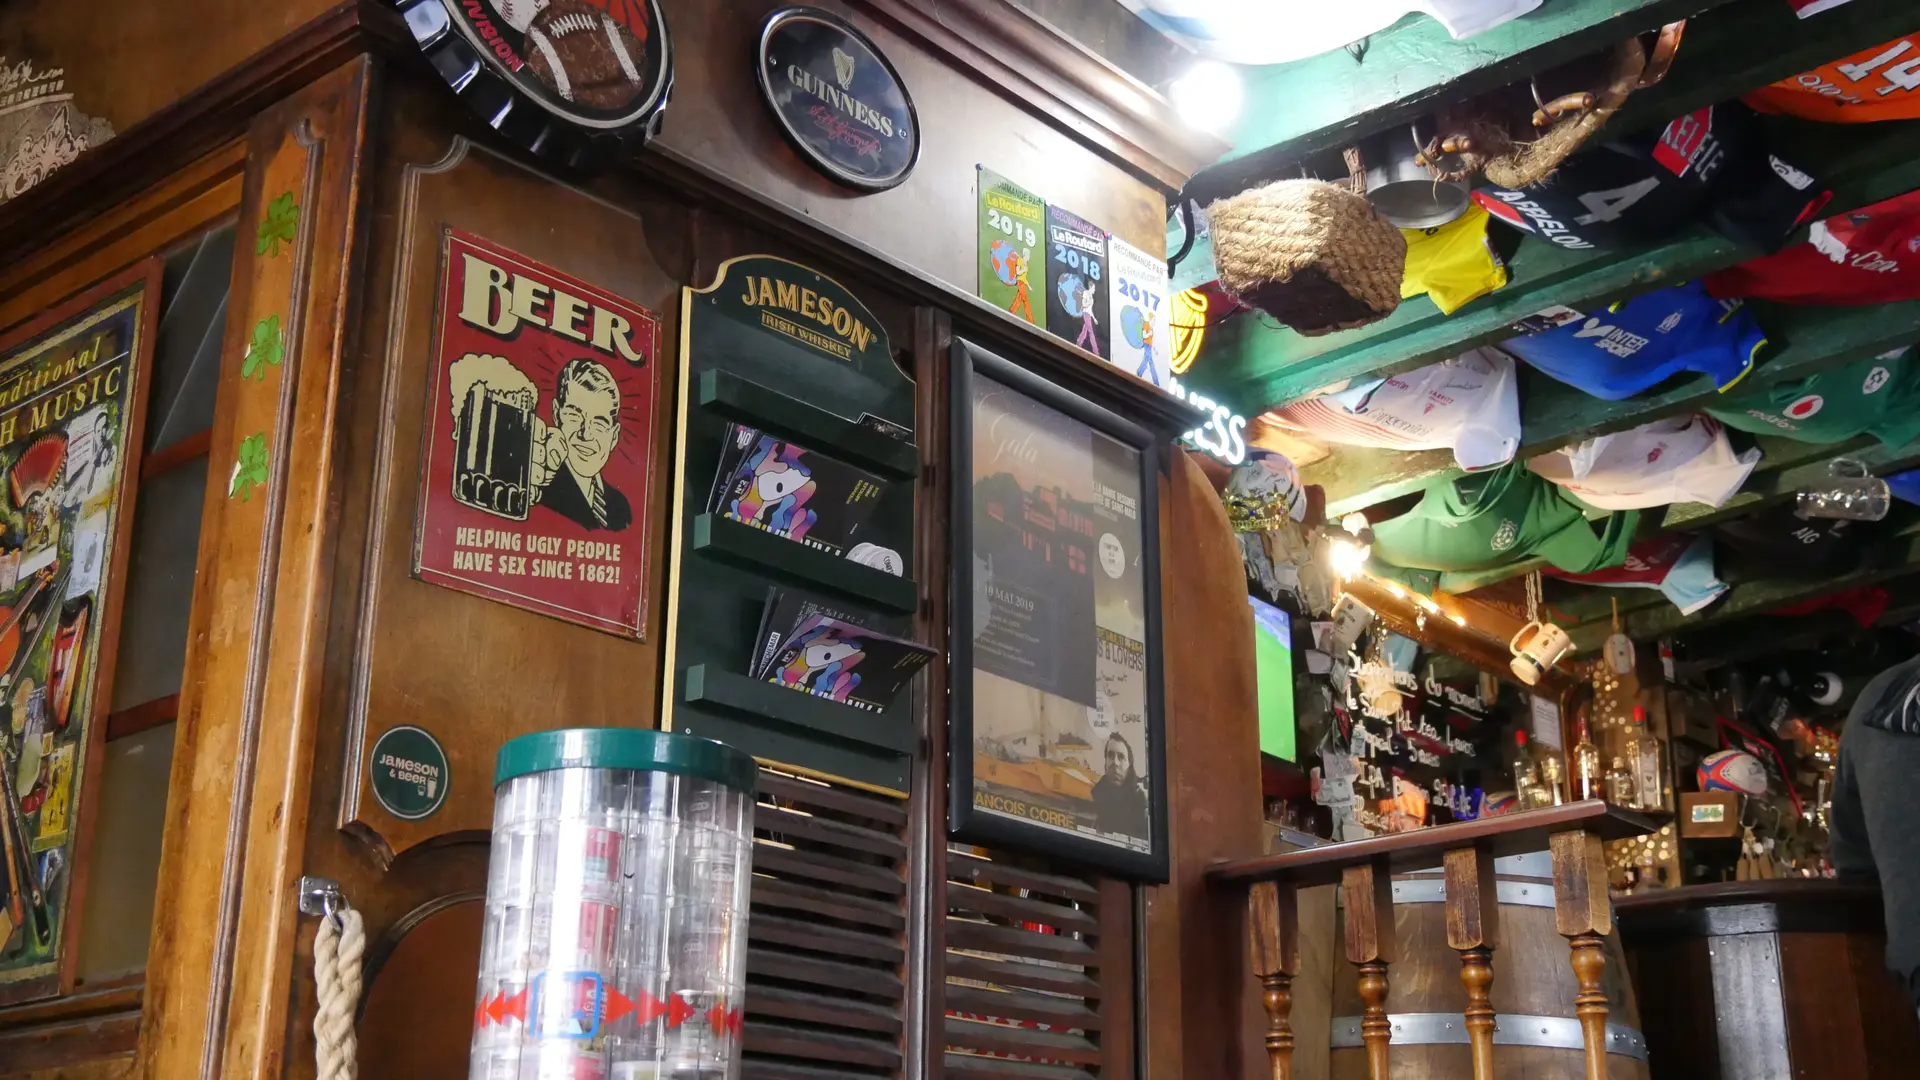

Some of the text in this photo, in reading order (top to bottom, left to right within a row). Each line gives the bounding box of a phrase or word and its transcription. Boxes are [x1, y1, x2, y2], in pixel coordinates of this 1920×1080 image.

[787, 64, 893, 138] GUINNESS
[986, 192, 1040, 219] Le Routard
[1573, 175, 1661, 227] 4
[986, 208, 1037, 248] 2019
[1493, 189, 1595, 250] AFFLELOU
[1053, 228, 1102, 252] Le Routard
[1054, 243, 1101, 281] 2018
[1151, 263, 1164, 276] PAR
[458, 252, 644, 362] BEER
[1118, 276, 1161, 312] 2017
[741, 275, 872, 353] JAMESON
[761, 311, 851, 359] IRISH WHISKEY
[1606, 328, 1649, 350] INTER
[29, 364, 122, 434] MUSIC
[455, 526, 622, 562] HELPING UGLY PEOPLE
[452, 550, 494, 573] HAVE
[531, 558, 573, 580] SINCE
[577, 562, 622, 585] 1862!
[995, 588, 1014, 604] MAI
[1015, 595, 1035, 612] 2019
[1112, 643, 1144, 672] LOVERS
[389, 768, 397, 779] &
